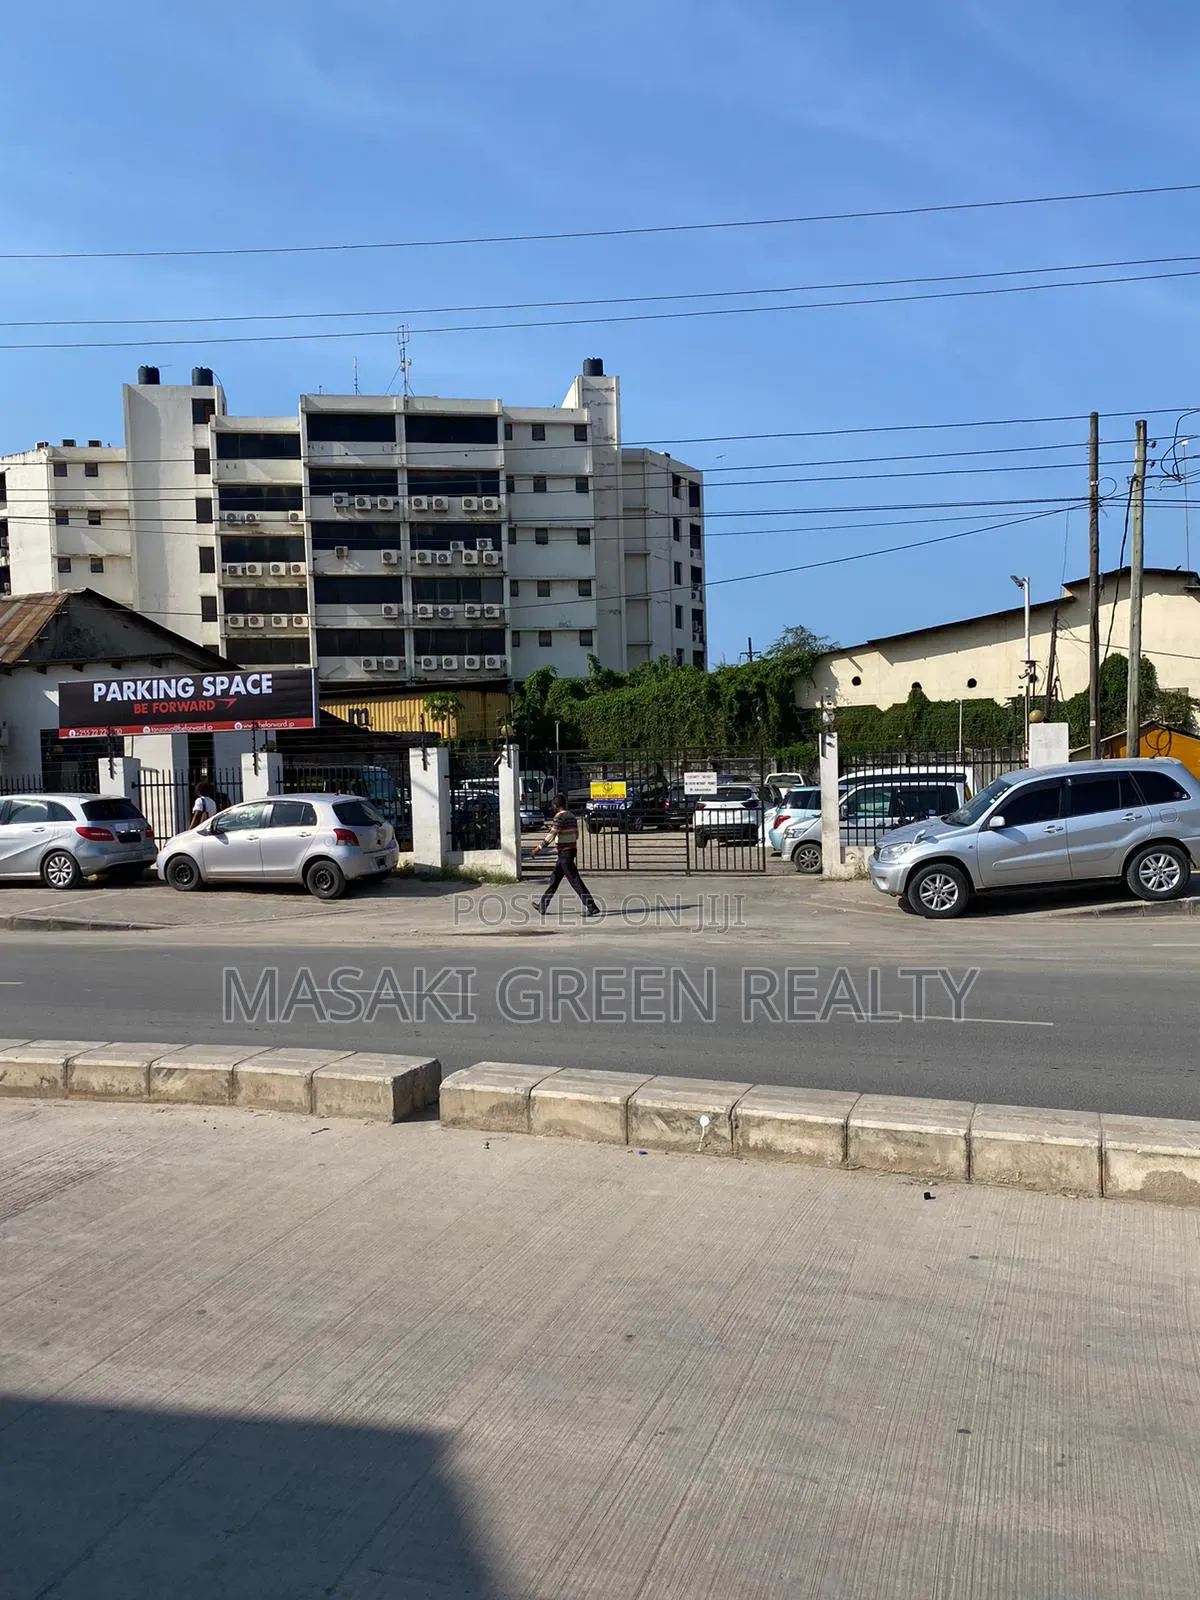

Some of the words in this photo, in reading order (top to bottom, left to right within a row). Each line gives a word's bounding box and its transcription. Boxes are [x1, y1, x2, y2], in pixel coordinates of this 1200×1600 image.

[93, 678, 195, 702] PARKING
[202, 673, 273, 697] SPACE
[133, 702, 149, 715] BE
[152, 700, 216, 713] FORWARD
